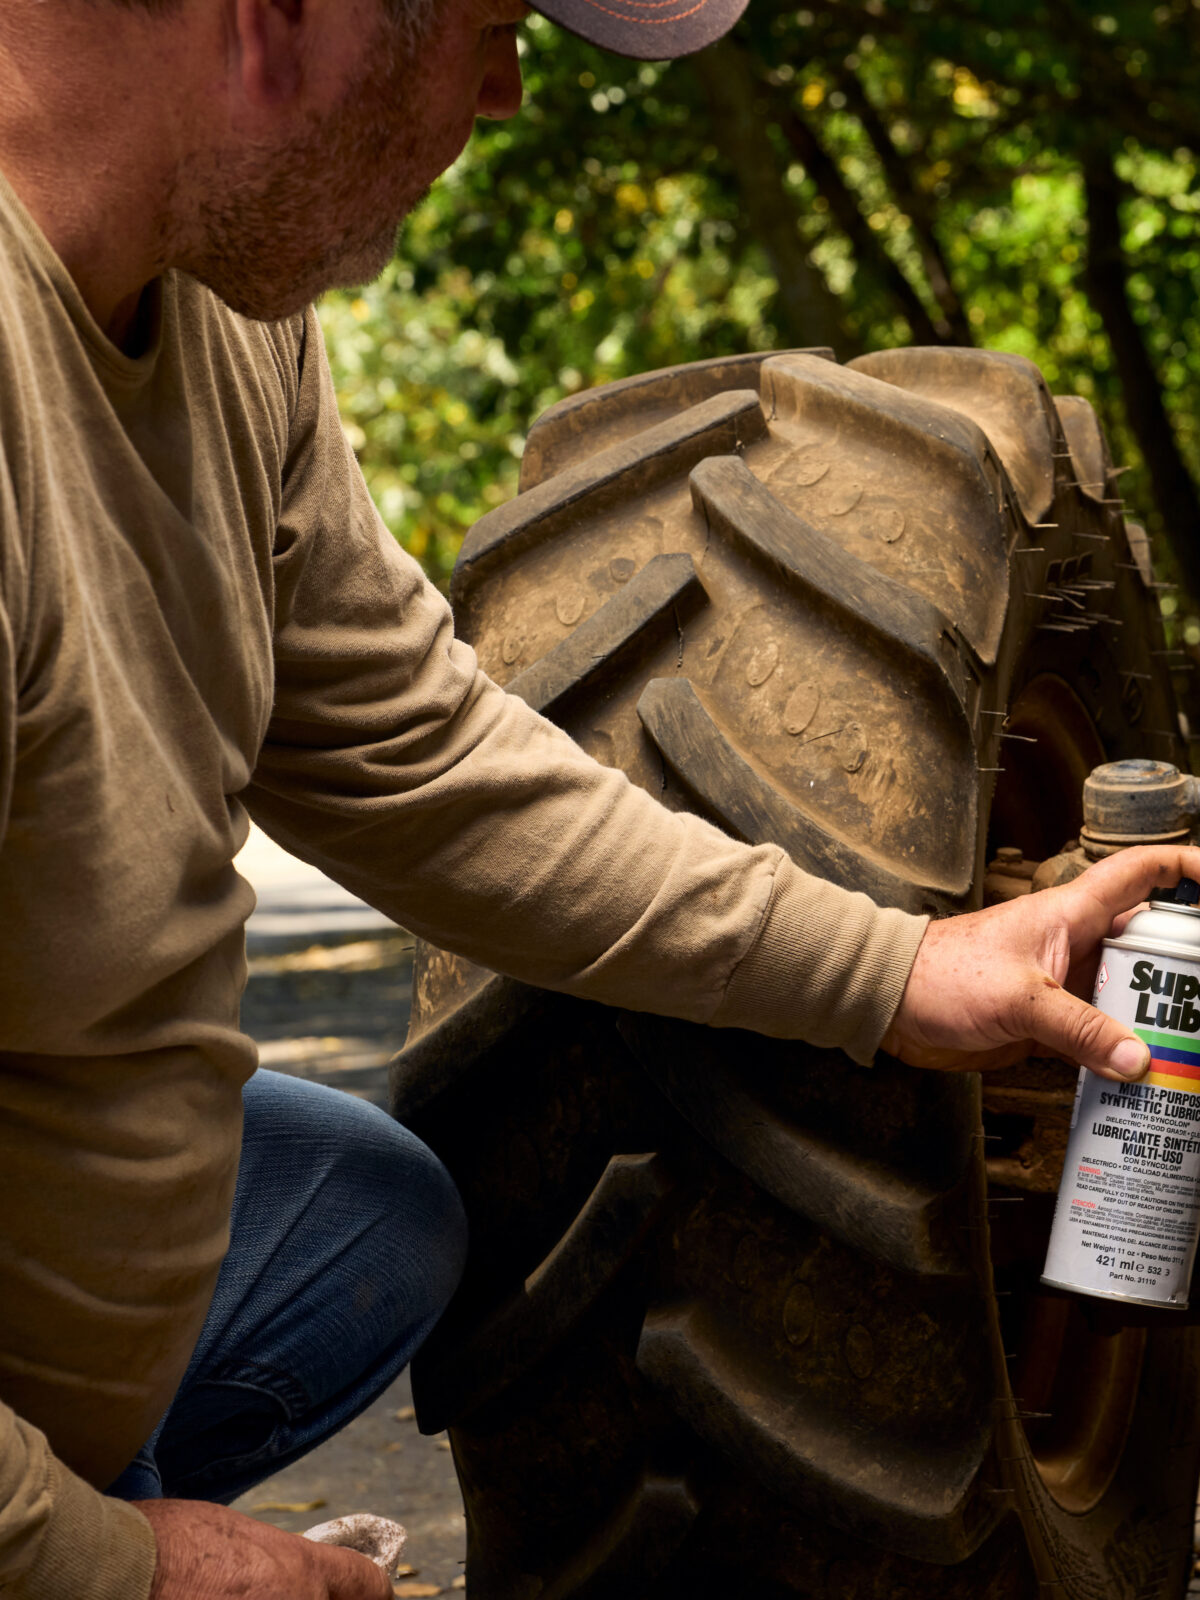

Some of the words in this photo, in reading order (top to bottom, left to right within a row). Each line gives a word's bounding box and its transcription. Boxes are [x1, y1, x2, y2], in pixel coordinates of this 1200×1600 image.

[1100, 1092, 1161, 1114] SYNTHETIC
[1106, 1116, 1141, 1128] DIELECTRIC
[1146, 1124, 1165, 1132] FOOD
[1166, 1128, 1186, 1136] GRADE
[1131, 1112, 1148, 1120] WITH
[1092, 1122, 1161, 1147] LUBRICANTE
[1122, 1142, 1183, 1165] MULTI-USO
[1124, 1156, 1140, 1165] CON
[1082, 1156, 1117, 1169] DIELECTRICO
[1133, 1166, 1160, 1176] CALIDAD
[1089, 1185, 1119, 1196] CAREFULLY
[1120, 1192, 1139, 1200] OTHER
[1141, 1195, 1168, 1205] CAUTIONS
[1103, 1196, 1117, 1204] KEEP
[1138, 1202, 1155, 1210] REACH
[1082, 1229, 1108, 1239] MANTENGA
[1109, 1234, 1126, 1243] FUERA
[1111, 1225, 1128, 1233] OTRAS
[1093, 1242, 1116, 1253] Weight
[1141, 1252, 1158, 1261] Peso
[1158, 1255, 1171, 1263] Neto
[1096, 1255, 1116, 1267] 421
[1119, 1260, 1135, 1271] ml
[1147, 1265, 1162, 1275] 532
[1109, 1271, 1124, 1280] Part
[1125, 1274, 1136, 1282] No.
[1137, 1277, 1156, 1285] 31110
